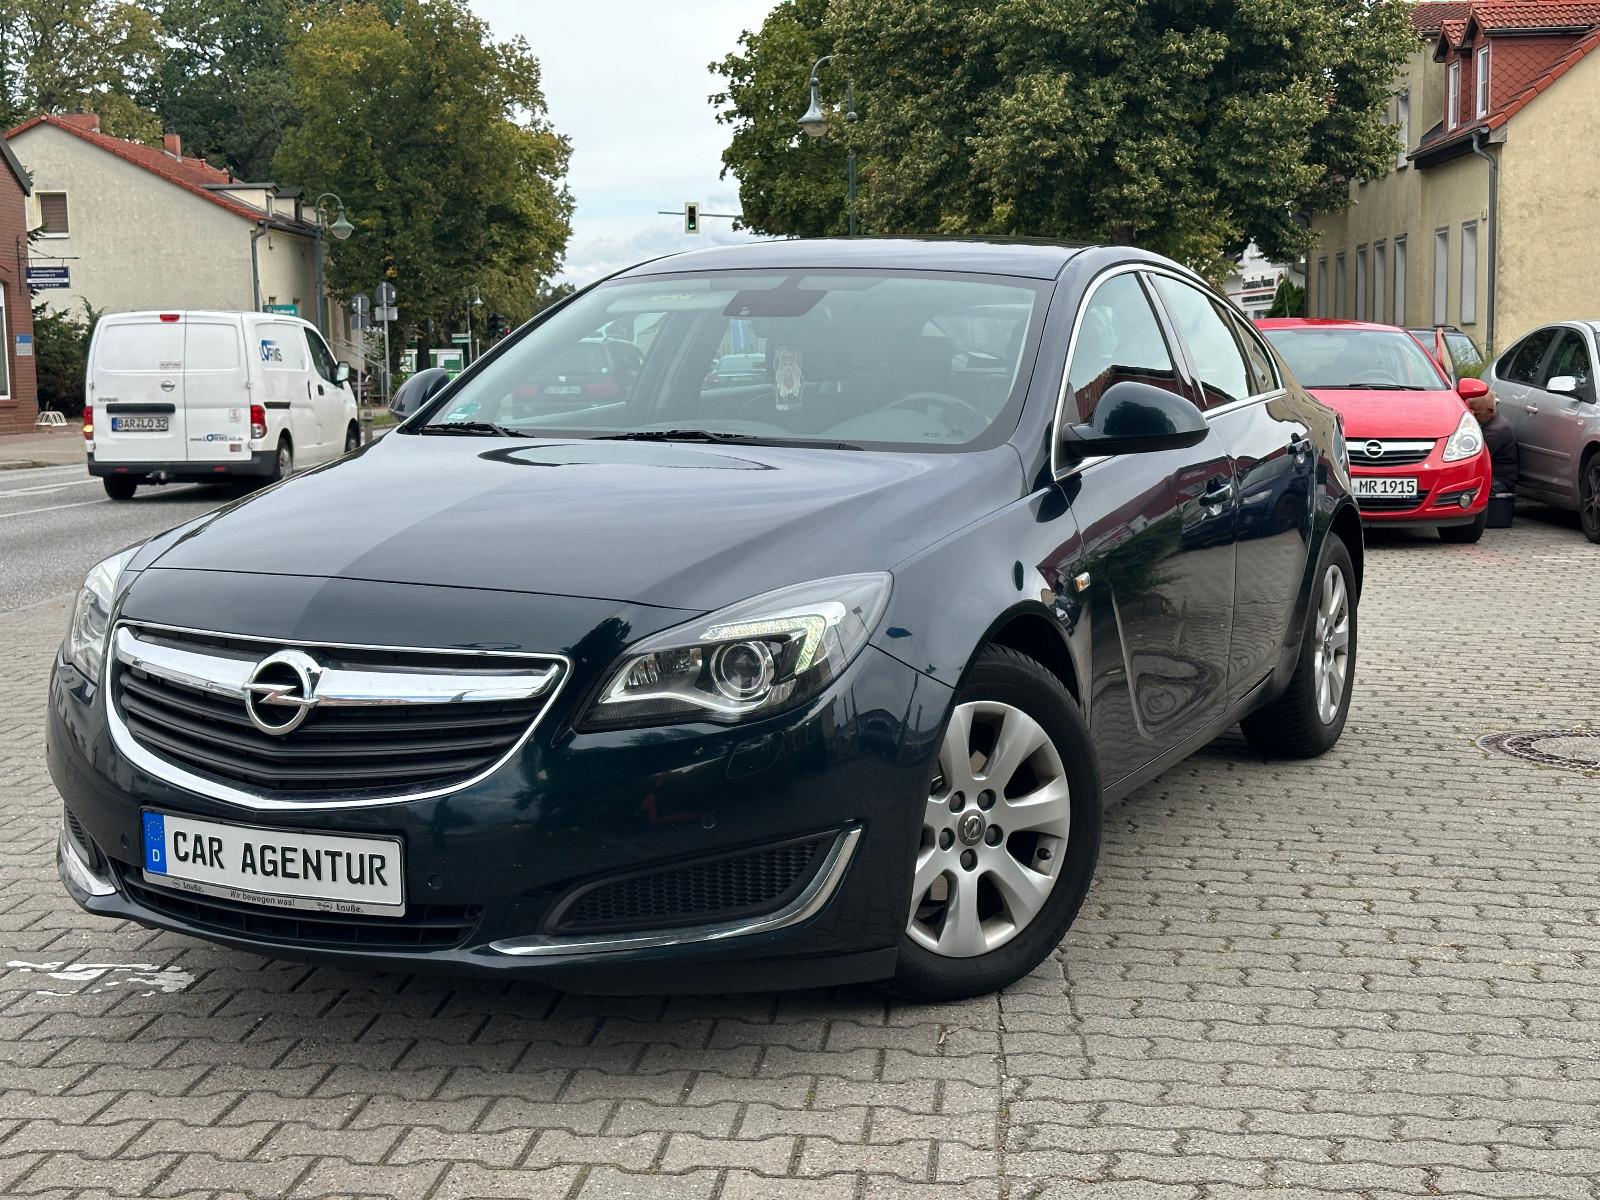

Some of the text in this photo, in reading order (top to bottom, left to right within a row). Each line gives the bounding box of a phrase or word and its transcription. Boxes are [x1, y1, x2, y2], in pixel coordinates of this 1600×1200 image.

[117, 418, 167, 428] BAR LO 32
[1359, 480, 1415, 493] MR 1915
[152, 849, 160, 862] D
[174, 831, 388, 886] CAR AGENTUR
[230, 889, 241, 898] Wir
[243, 892, 275, 904] bewegen
[277, 898, 296, 906] was!
